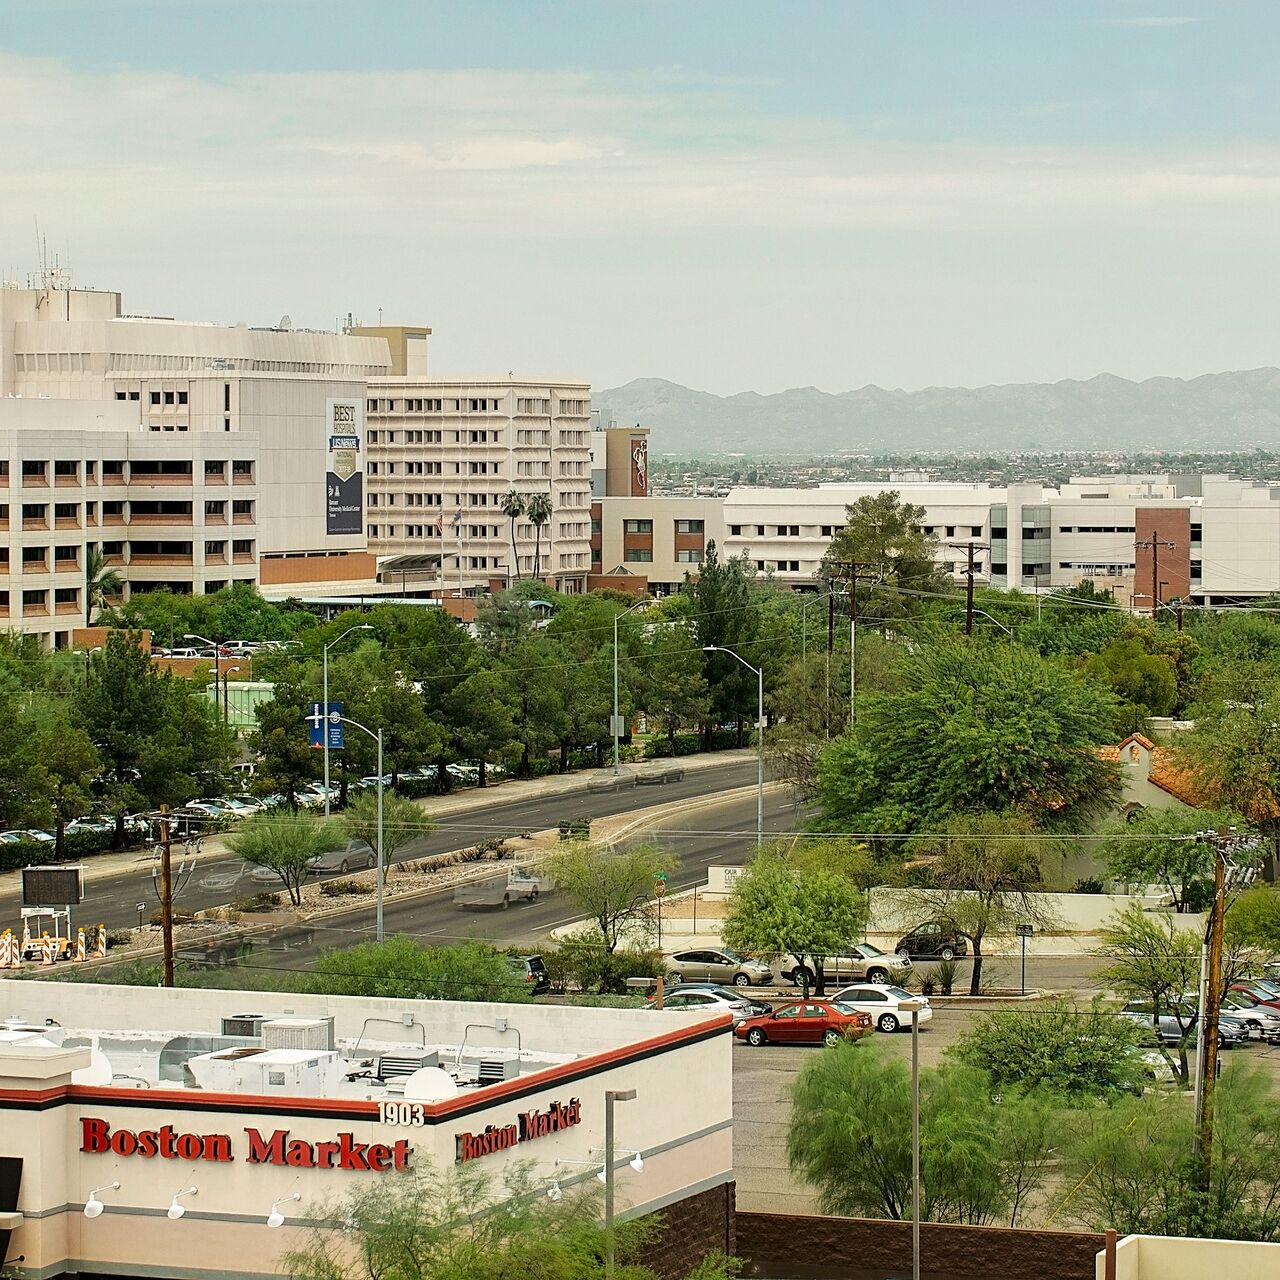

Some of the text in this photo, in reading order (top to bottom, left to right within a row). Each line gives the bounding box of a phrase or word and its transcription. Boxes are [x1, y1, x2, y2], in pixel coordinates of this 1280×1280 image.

[333, 405, 355, 421] BEST
[333, 423, 356, 434] HOSPITALS
[378, 1101, 425, 1127] 1903
[454, 1097, 583, 1165] Boston Market
[80, 1117, 415, 1174] Boston Market
